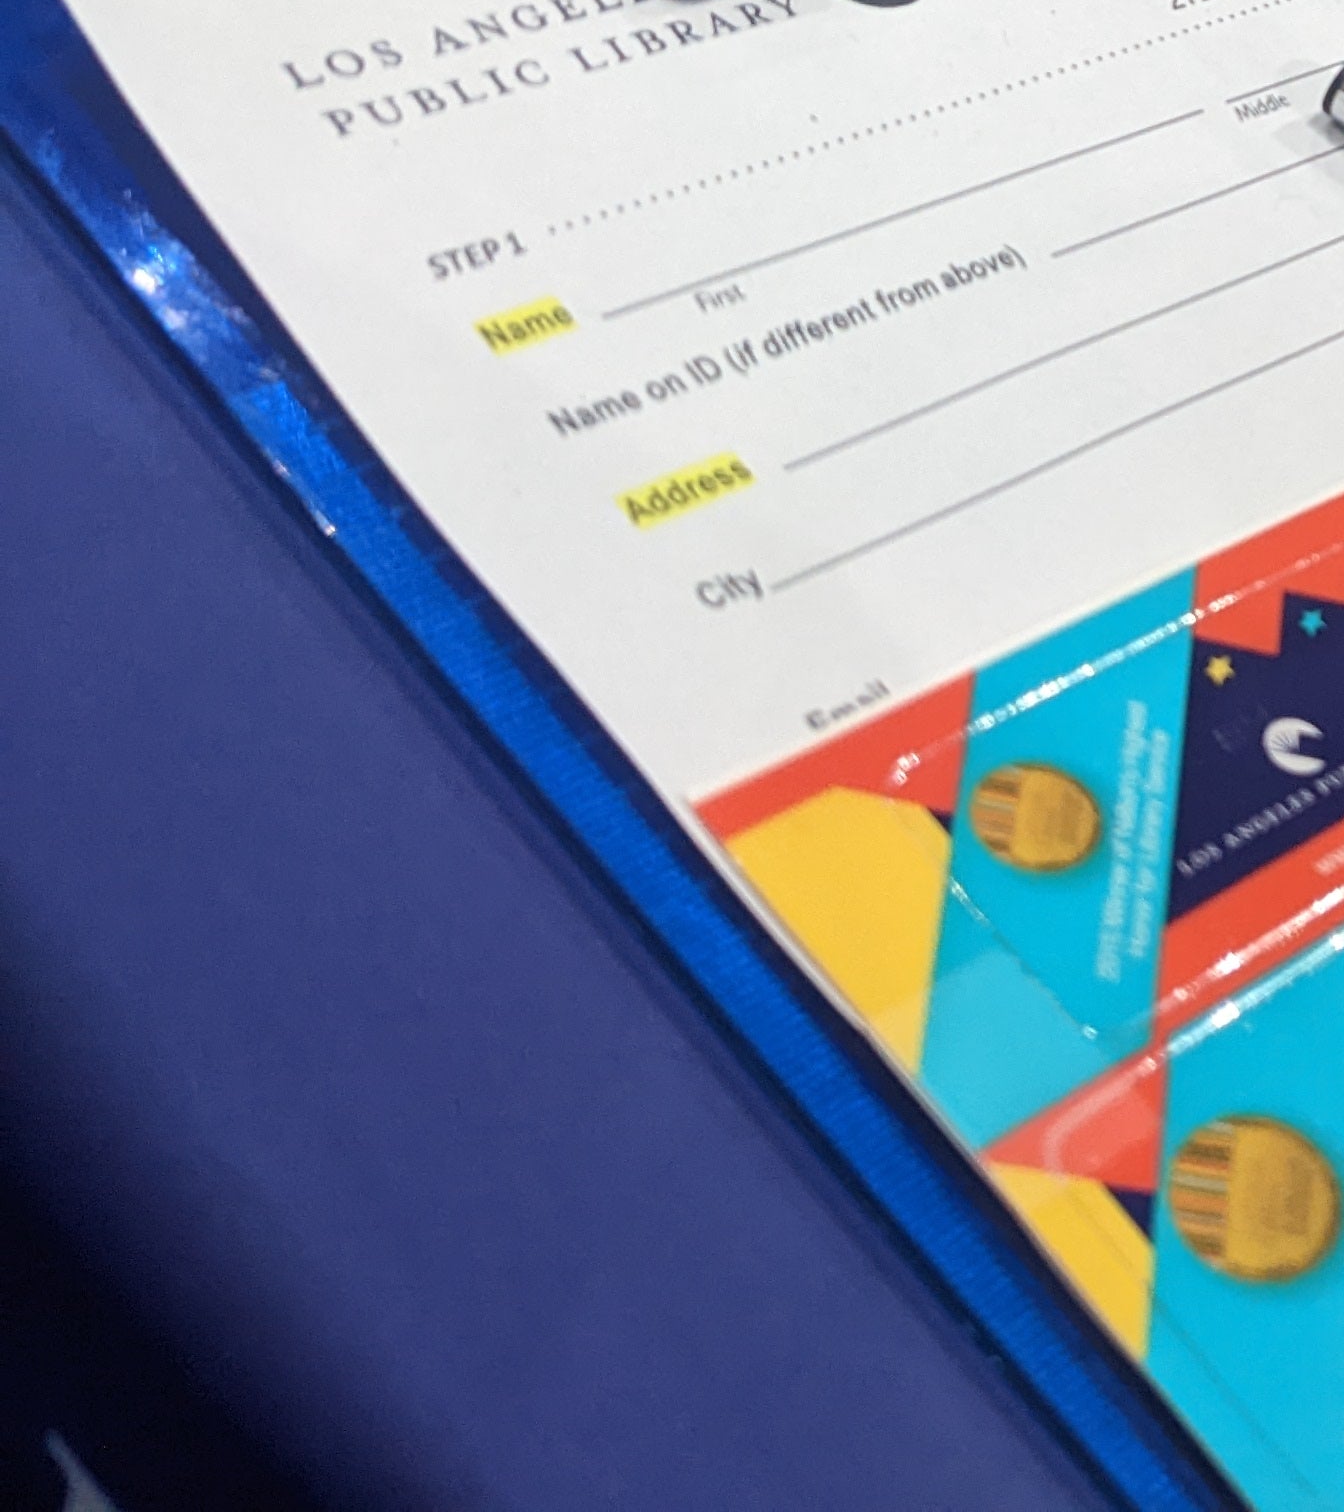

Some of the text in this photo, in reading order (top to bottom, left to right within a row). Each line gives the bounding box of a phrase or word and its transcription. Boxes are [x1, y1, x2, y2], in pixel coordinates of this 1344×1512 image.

[282, 37, 404, 91] LOS
[322, 57, 551, 137] PUBLIC
[1234, 93, 1289, 122] Middle
[427, 232, 525, 282] STEP 1
[696, 284, 746, 313] First
[480, 304, 575, 352] Name
[547, 244, 1027, 438] Name on ID (if different from above)
[625, 459, 753, 525] Address
[695, 570, 765, 612] City
